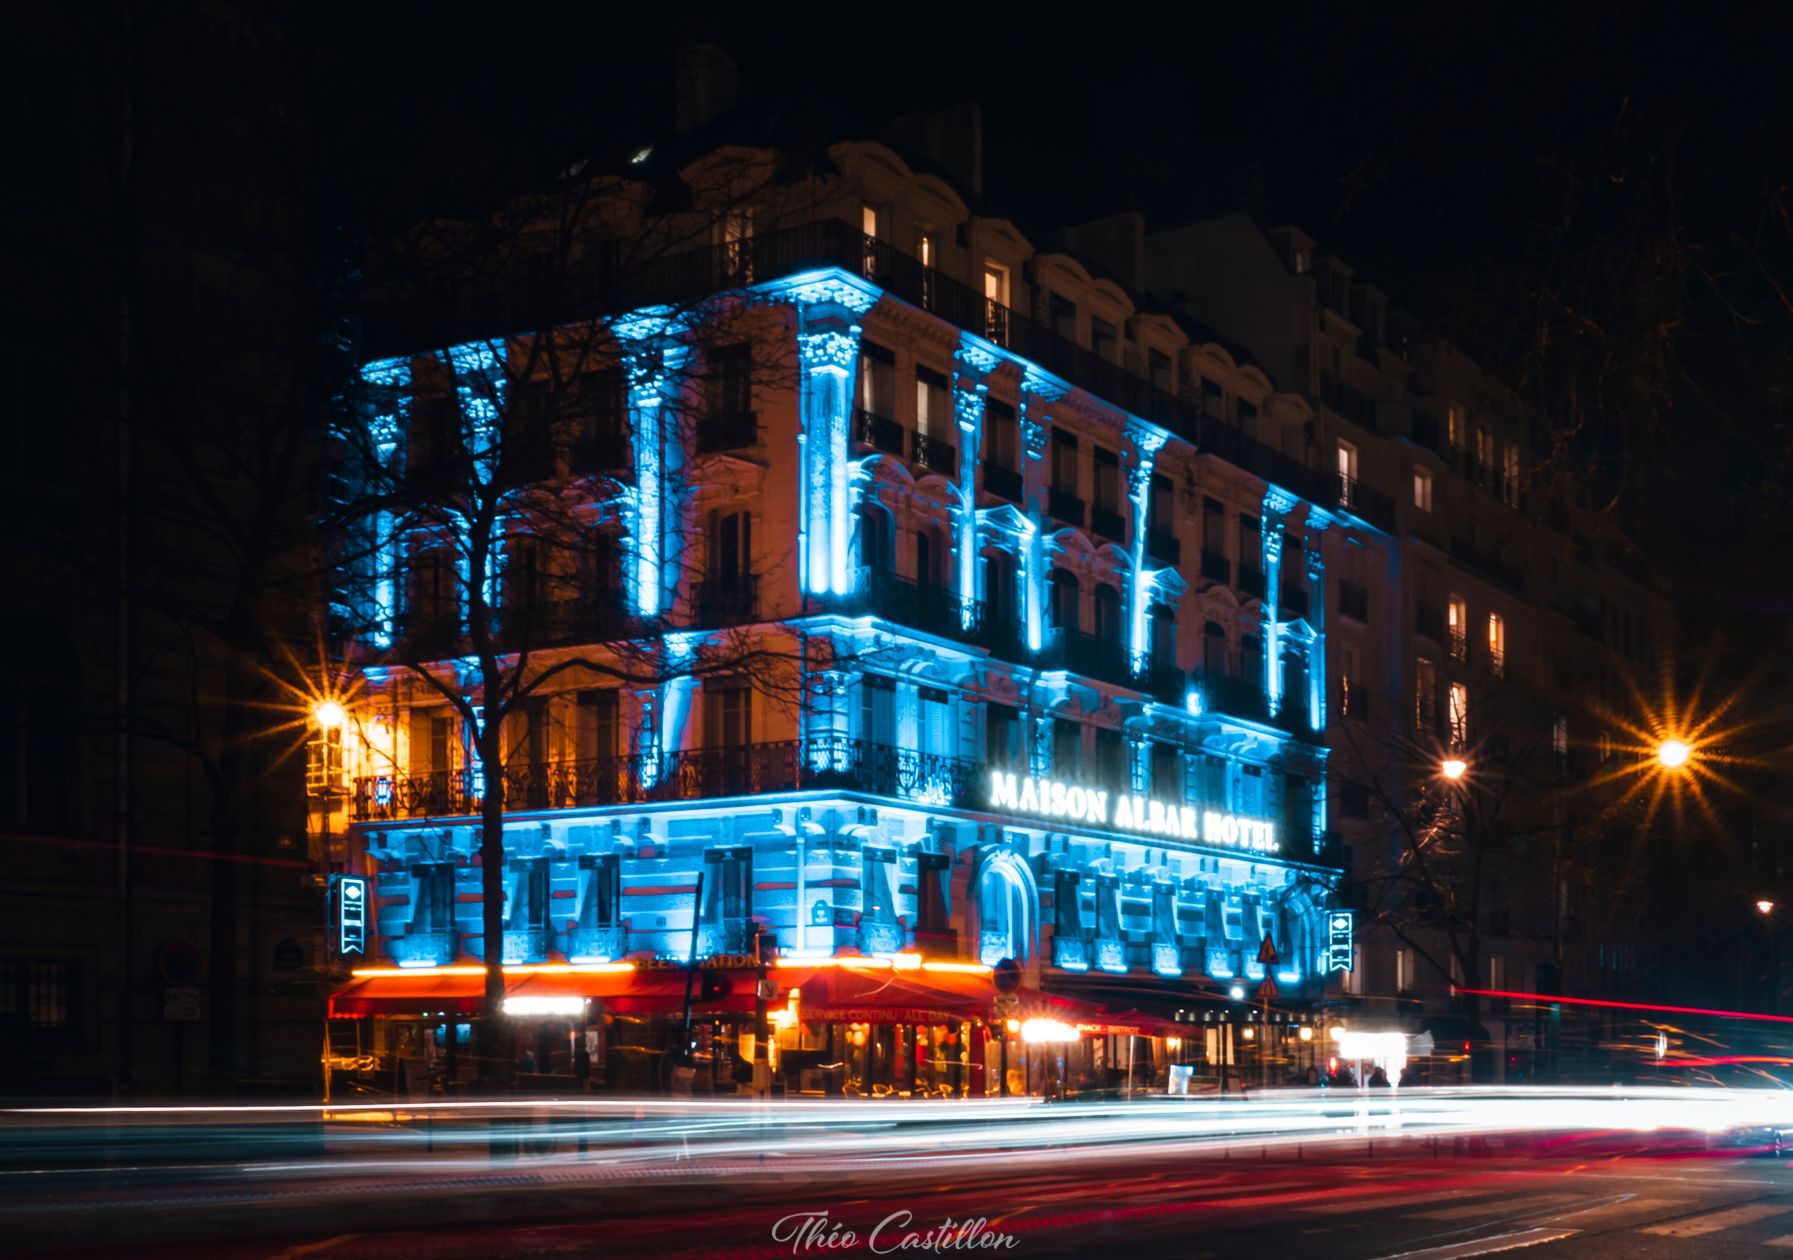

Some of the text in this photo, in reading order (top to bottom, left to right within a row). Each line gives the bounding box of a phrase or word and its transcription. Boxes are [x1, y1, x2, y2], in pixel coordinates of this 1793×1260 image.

[990, 771, 1279, 851] MAISON ALBAR HOTEL
[805, 1008, 845, 1020] SERVICE
[848, 1009, 896, 1021] CONTINU
